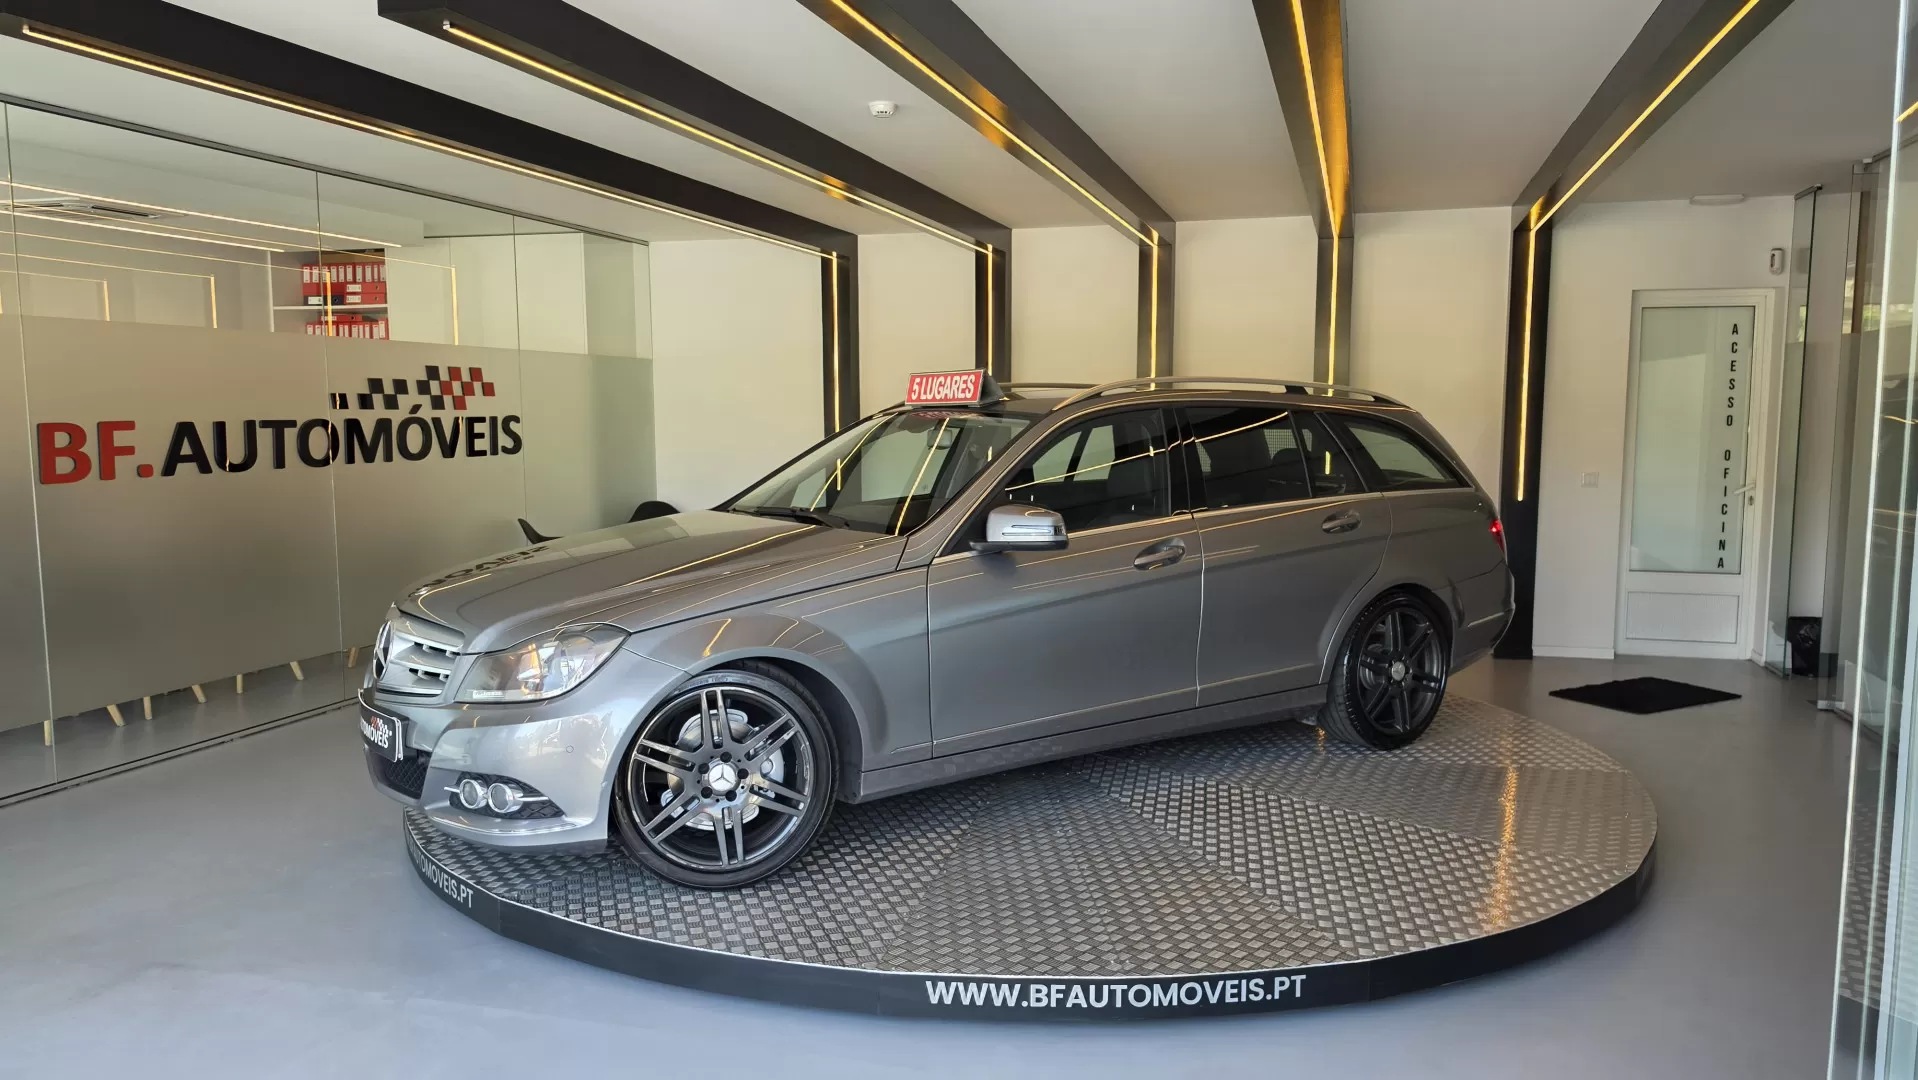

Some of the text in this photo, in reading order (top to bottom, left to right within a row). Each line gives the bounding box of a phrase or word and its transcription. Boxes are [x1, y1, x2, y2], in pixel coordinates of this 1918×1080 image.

[911, 374, 976, 400] 5 LUGARES
[1717, 323, 1739, 569] ACESSO OFICINA
[925, 974, 1307, 1008] WWW.BFAUTOMOVEIS.PT
